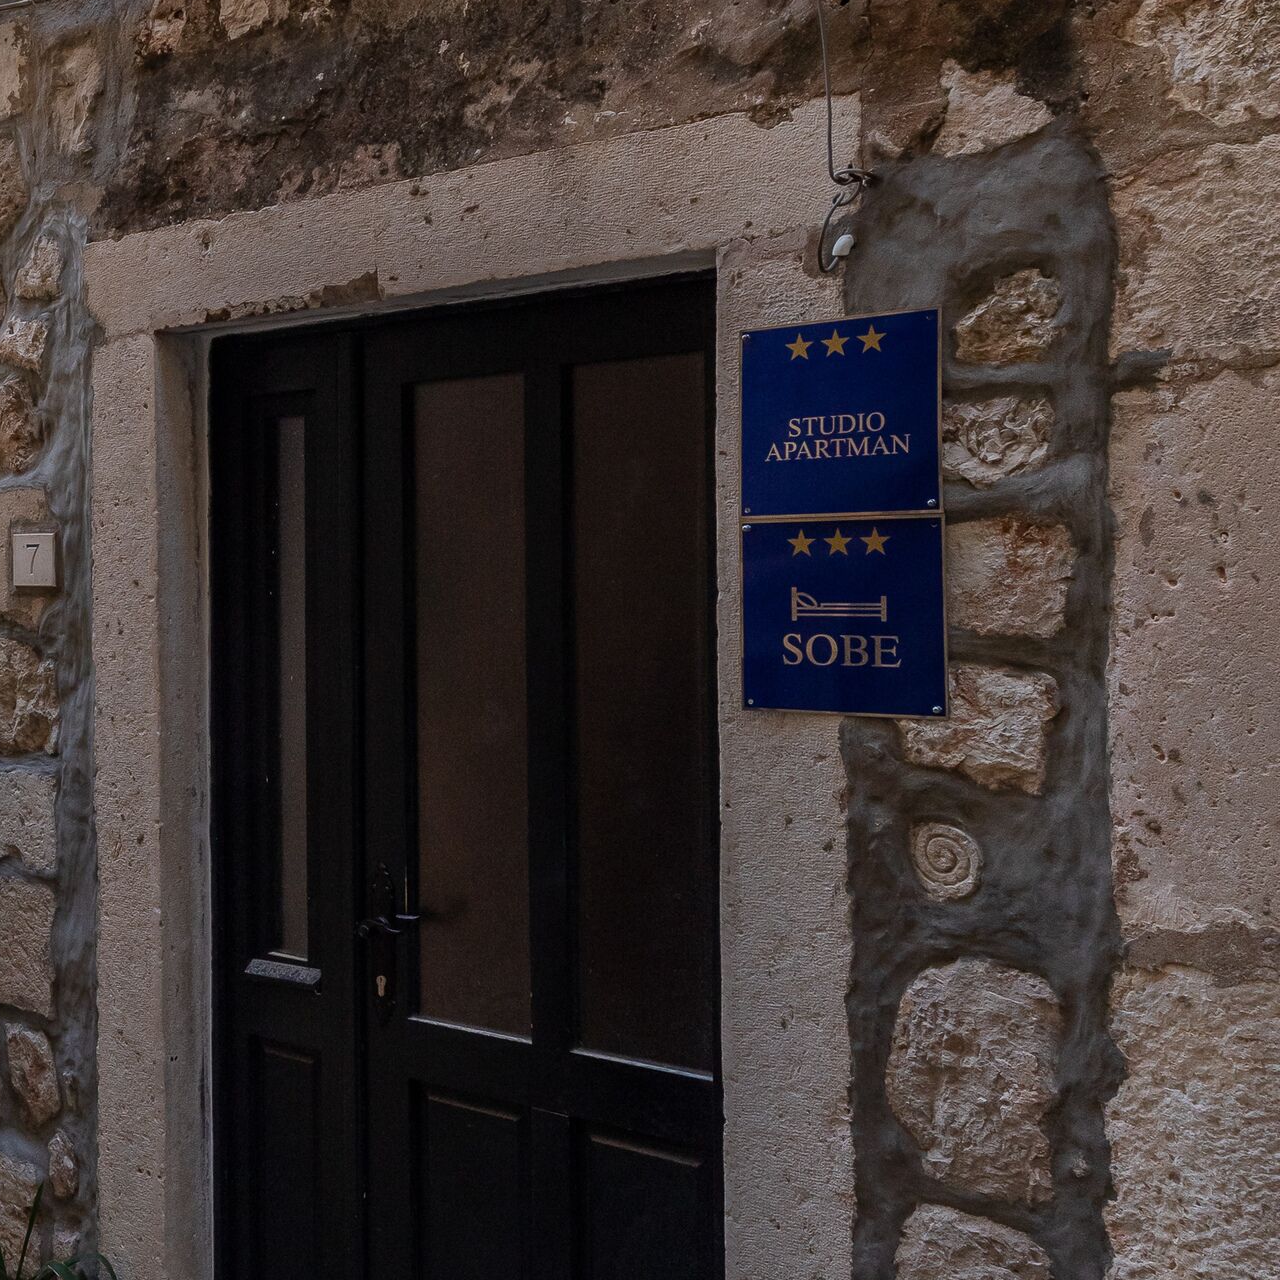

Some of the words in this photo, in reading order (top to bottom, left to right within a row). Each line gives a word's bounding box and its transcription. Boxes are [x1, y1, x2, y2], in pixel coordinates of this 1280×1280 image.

[788, 412, 886, 438] STUDIO
[764, 434, 911, 462] APARTMAN
[26, 543, 41, 575] 7
[782, 633, 902, 668] SOBE
